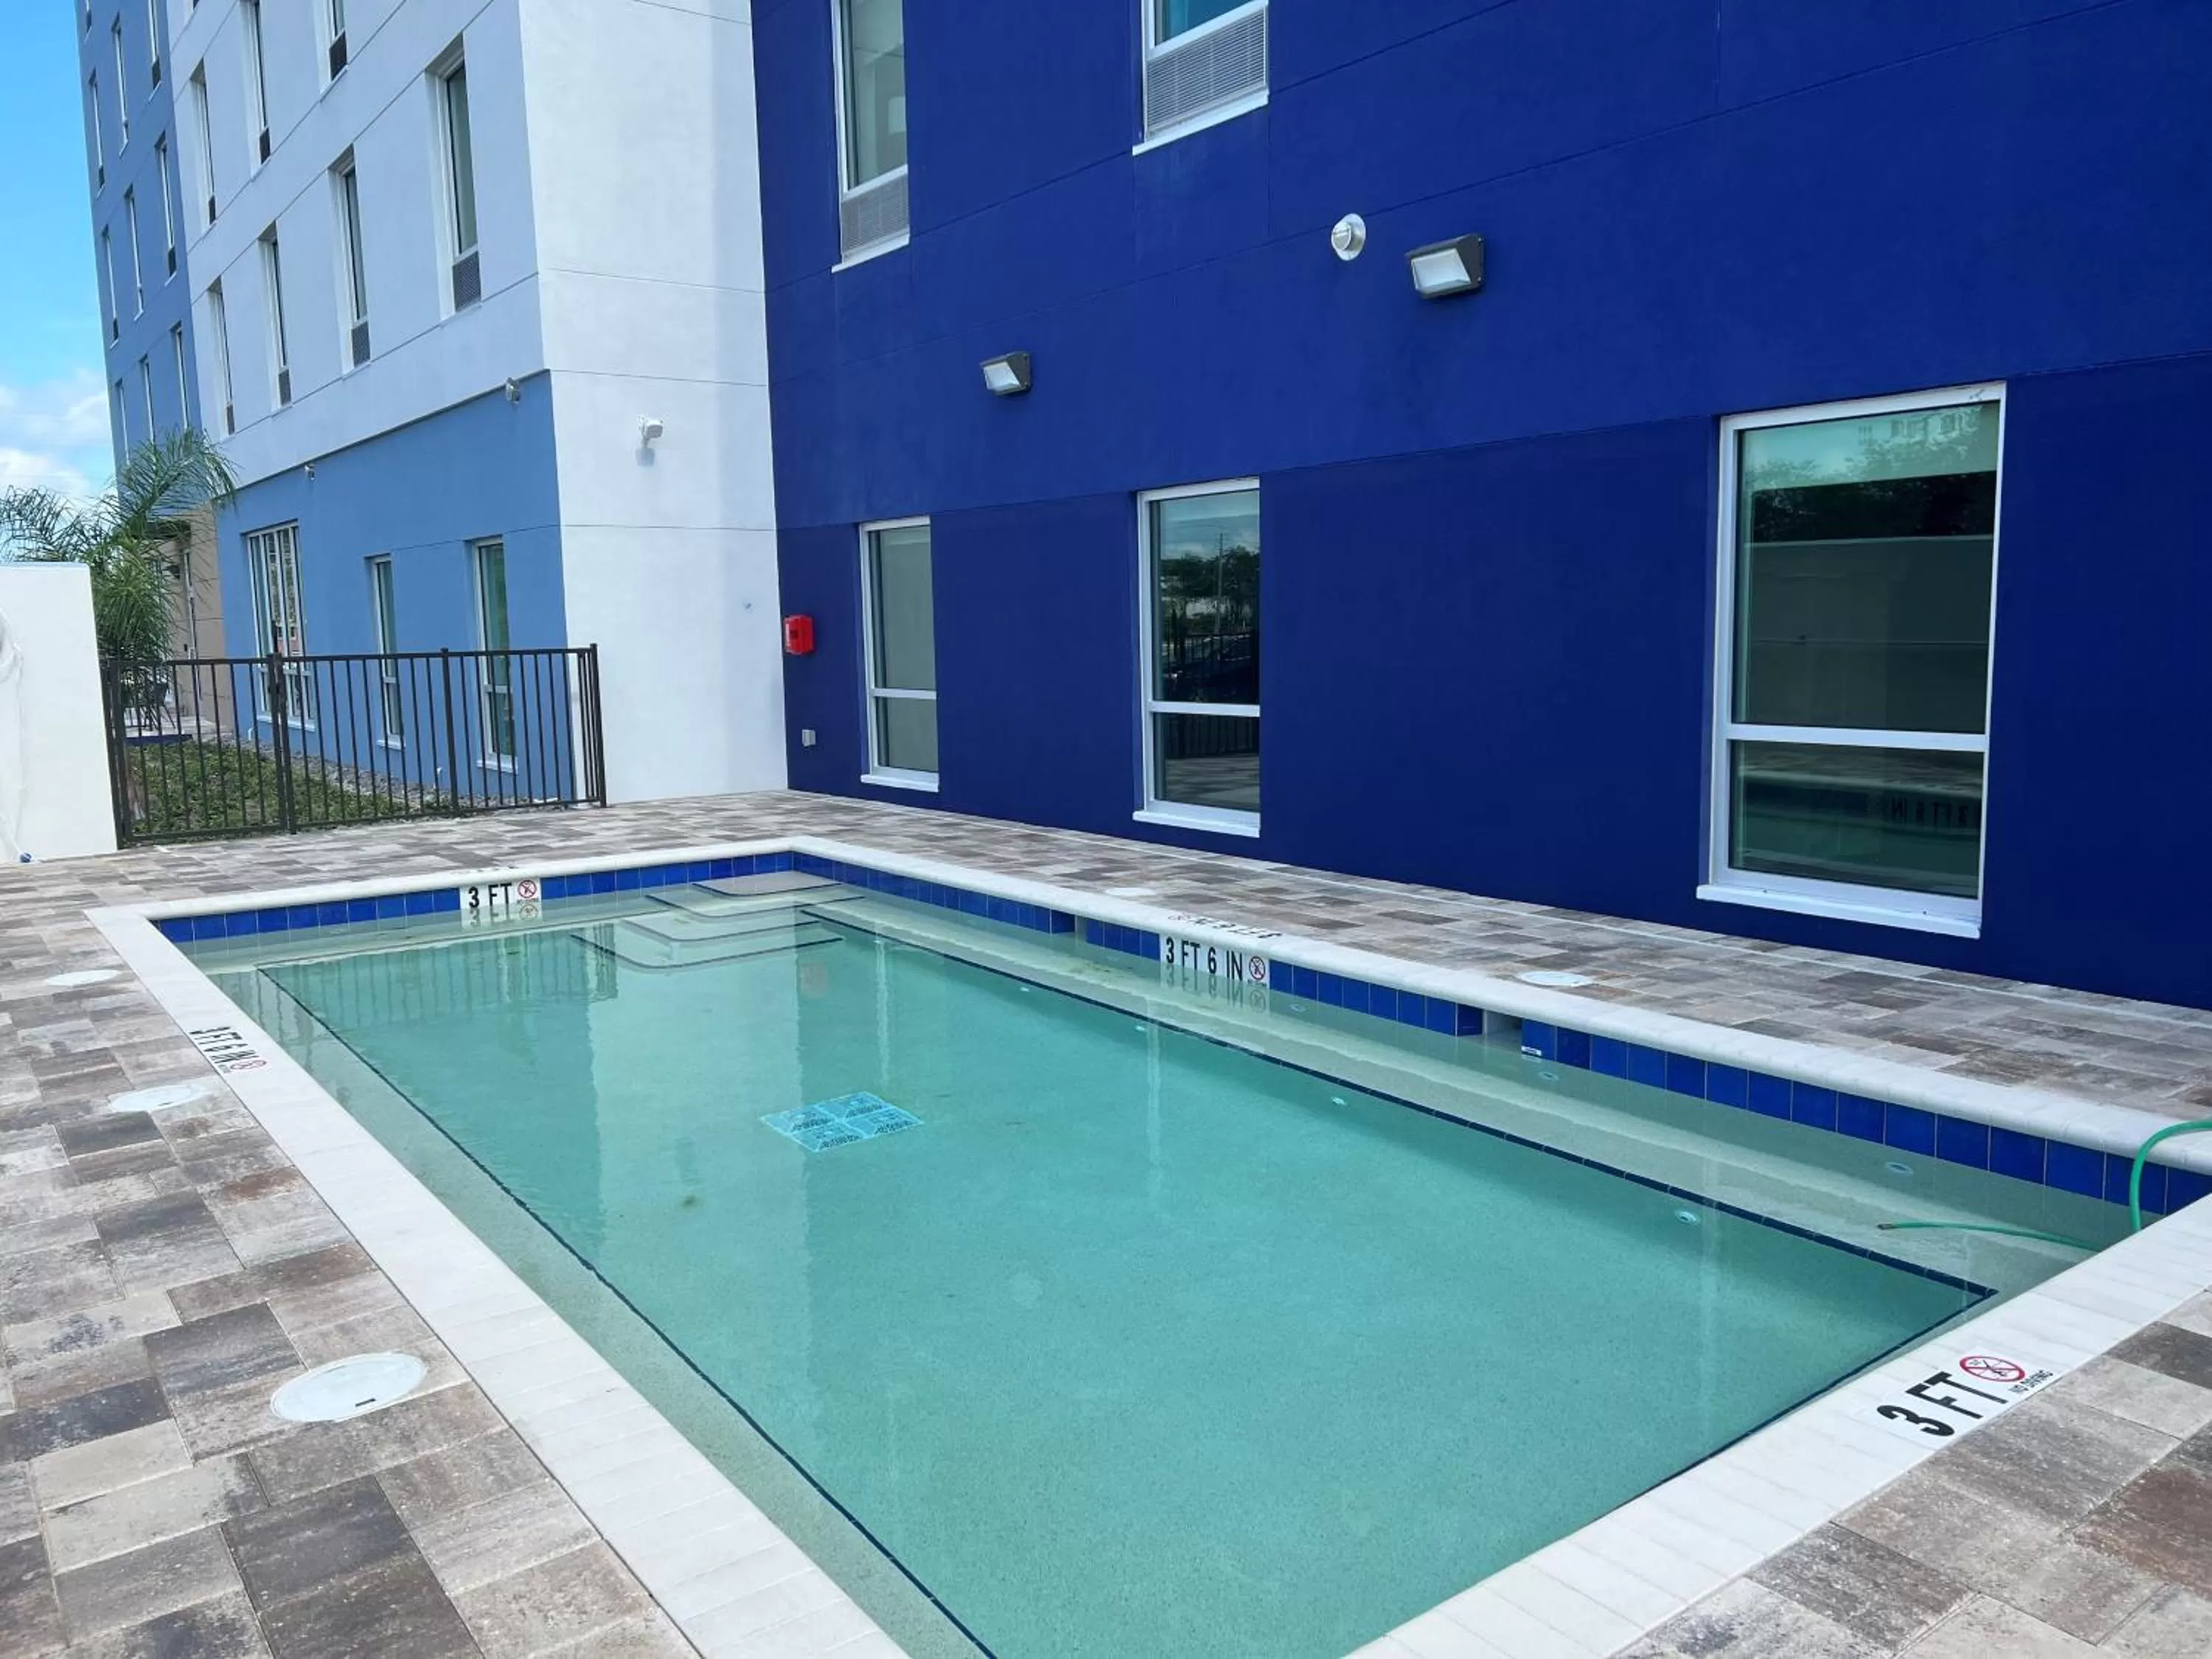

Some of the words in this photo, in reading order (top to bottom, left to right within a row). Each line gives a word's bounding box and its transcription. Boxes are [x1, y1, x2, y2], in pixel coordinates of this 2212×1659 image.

[468, 886, 480, 908] 3
[488, 883, 512, 906] FT
[1166, 936, 1175, 964] 3
[1180, 940, 1200, 970] FT
[1208, 947, 1217, 974] 6
[1226, 950, 1242, 981] IN
[194, 1032, 243, 1045] FT
[209, 1049, 260, 1064] IN
[1905, 1371, 2008, 1419] FT
[1877, 1405, 1955, 1436] 3
